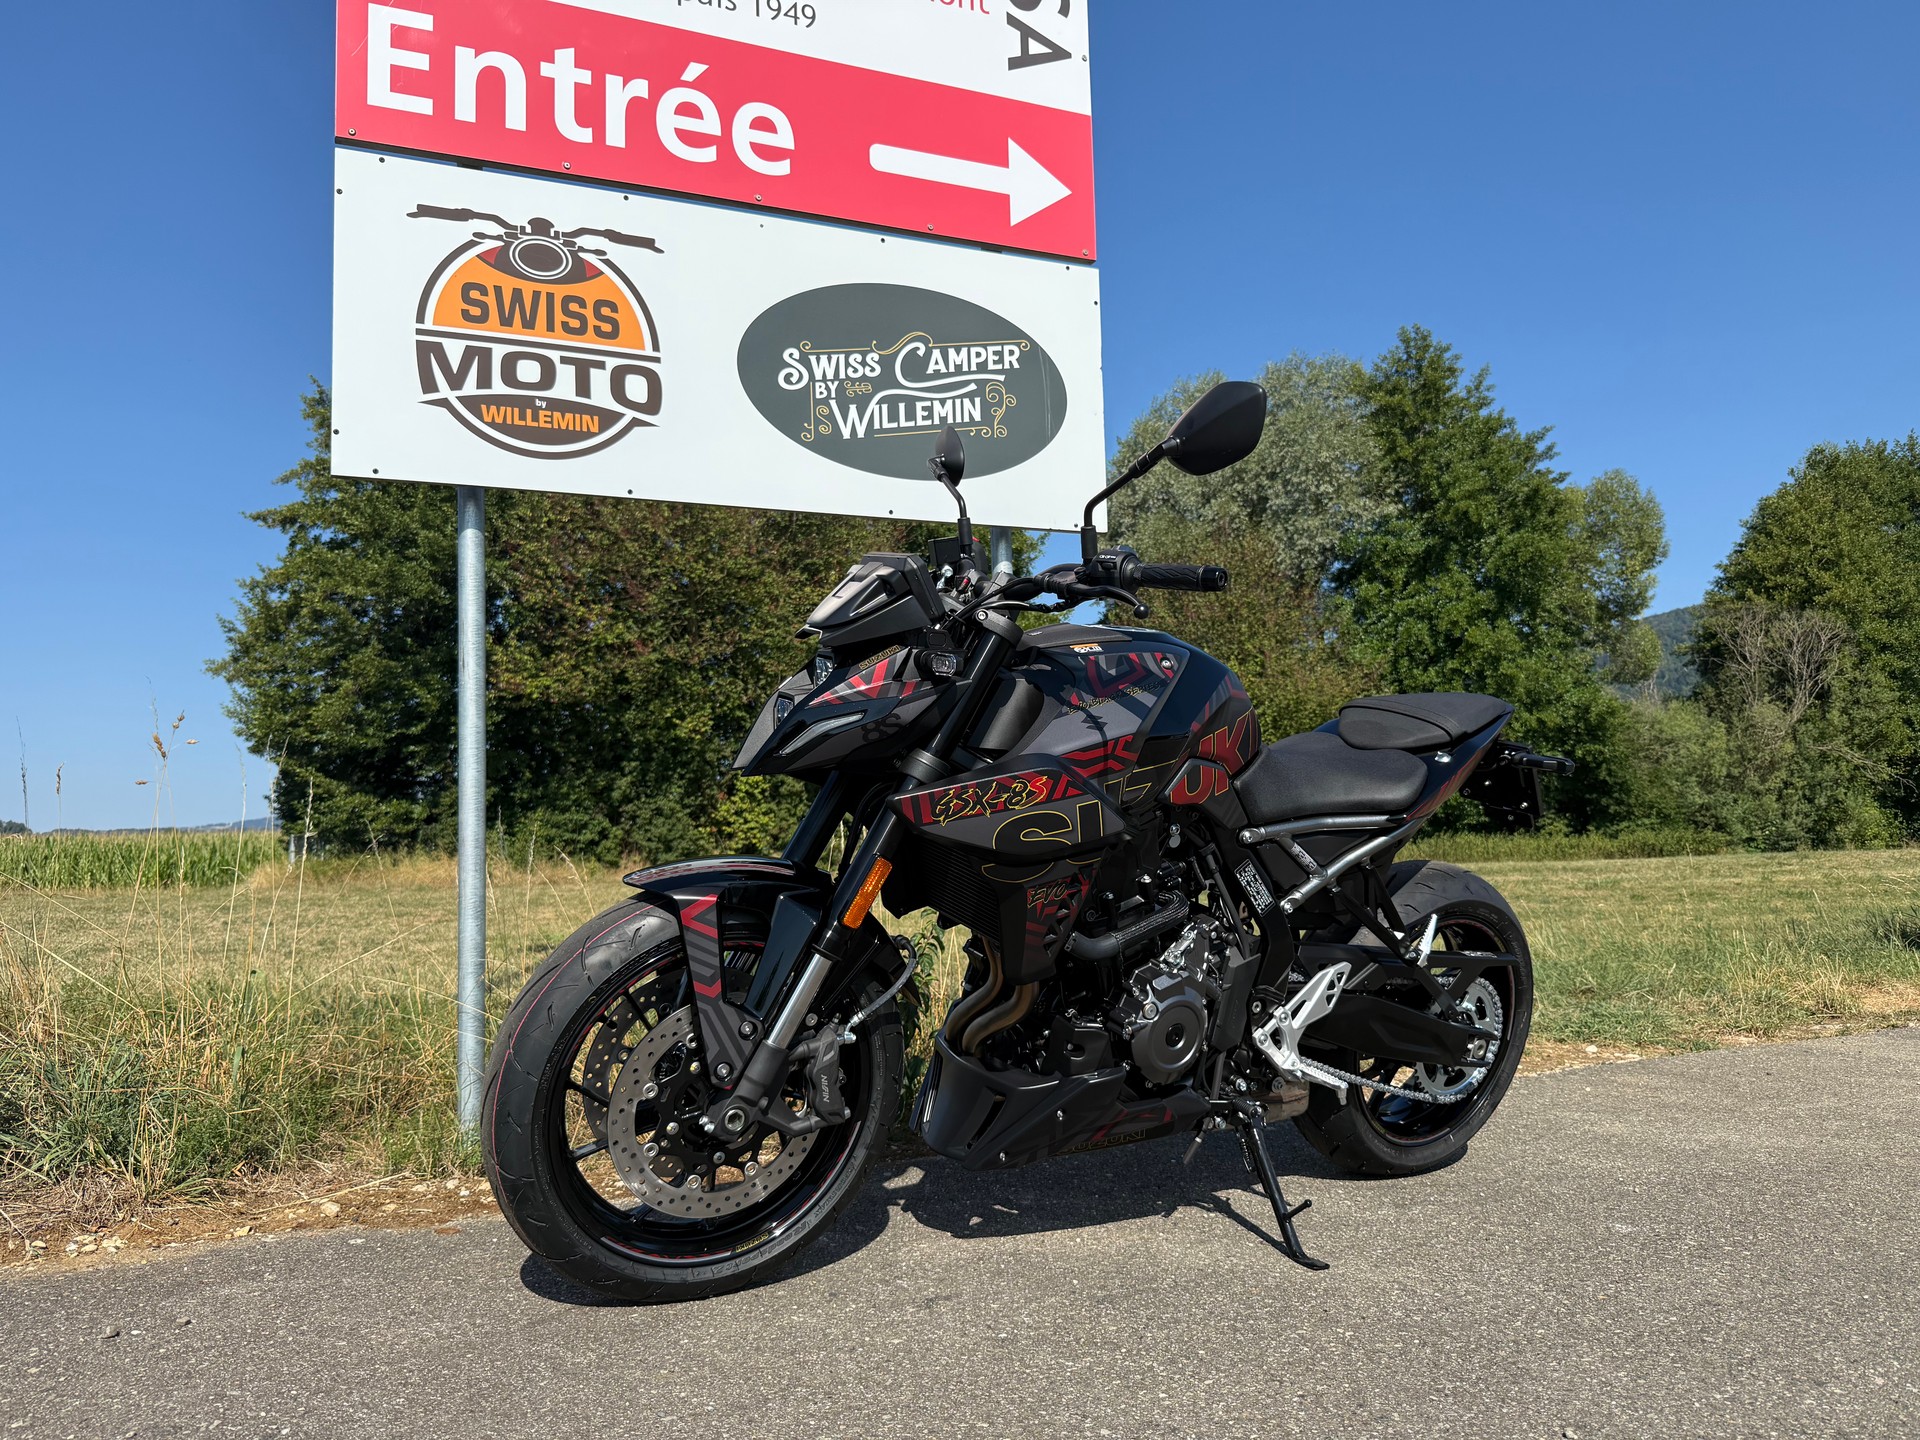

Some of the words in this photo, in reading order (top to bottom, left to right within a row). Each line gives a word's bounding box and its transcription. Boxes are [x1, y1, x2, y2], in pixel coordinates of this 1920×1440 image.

[754, 0, 817, 29] 1949
[366, 2, 796, 177] Entrée
[460, 281, 620, 341] SWISS
[415, 339, 663, 416] MOTO
[480, 404, 599, 433] WILLEMIN
[535, 399, 547, 408] by
[858, 644, 902, 671] SUZUKI
[930, 775, 1049, 827] GSX-8S
